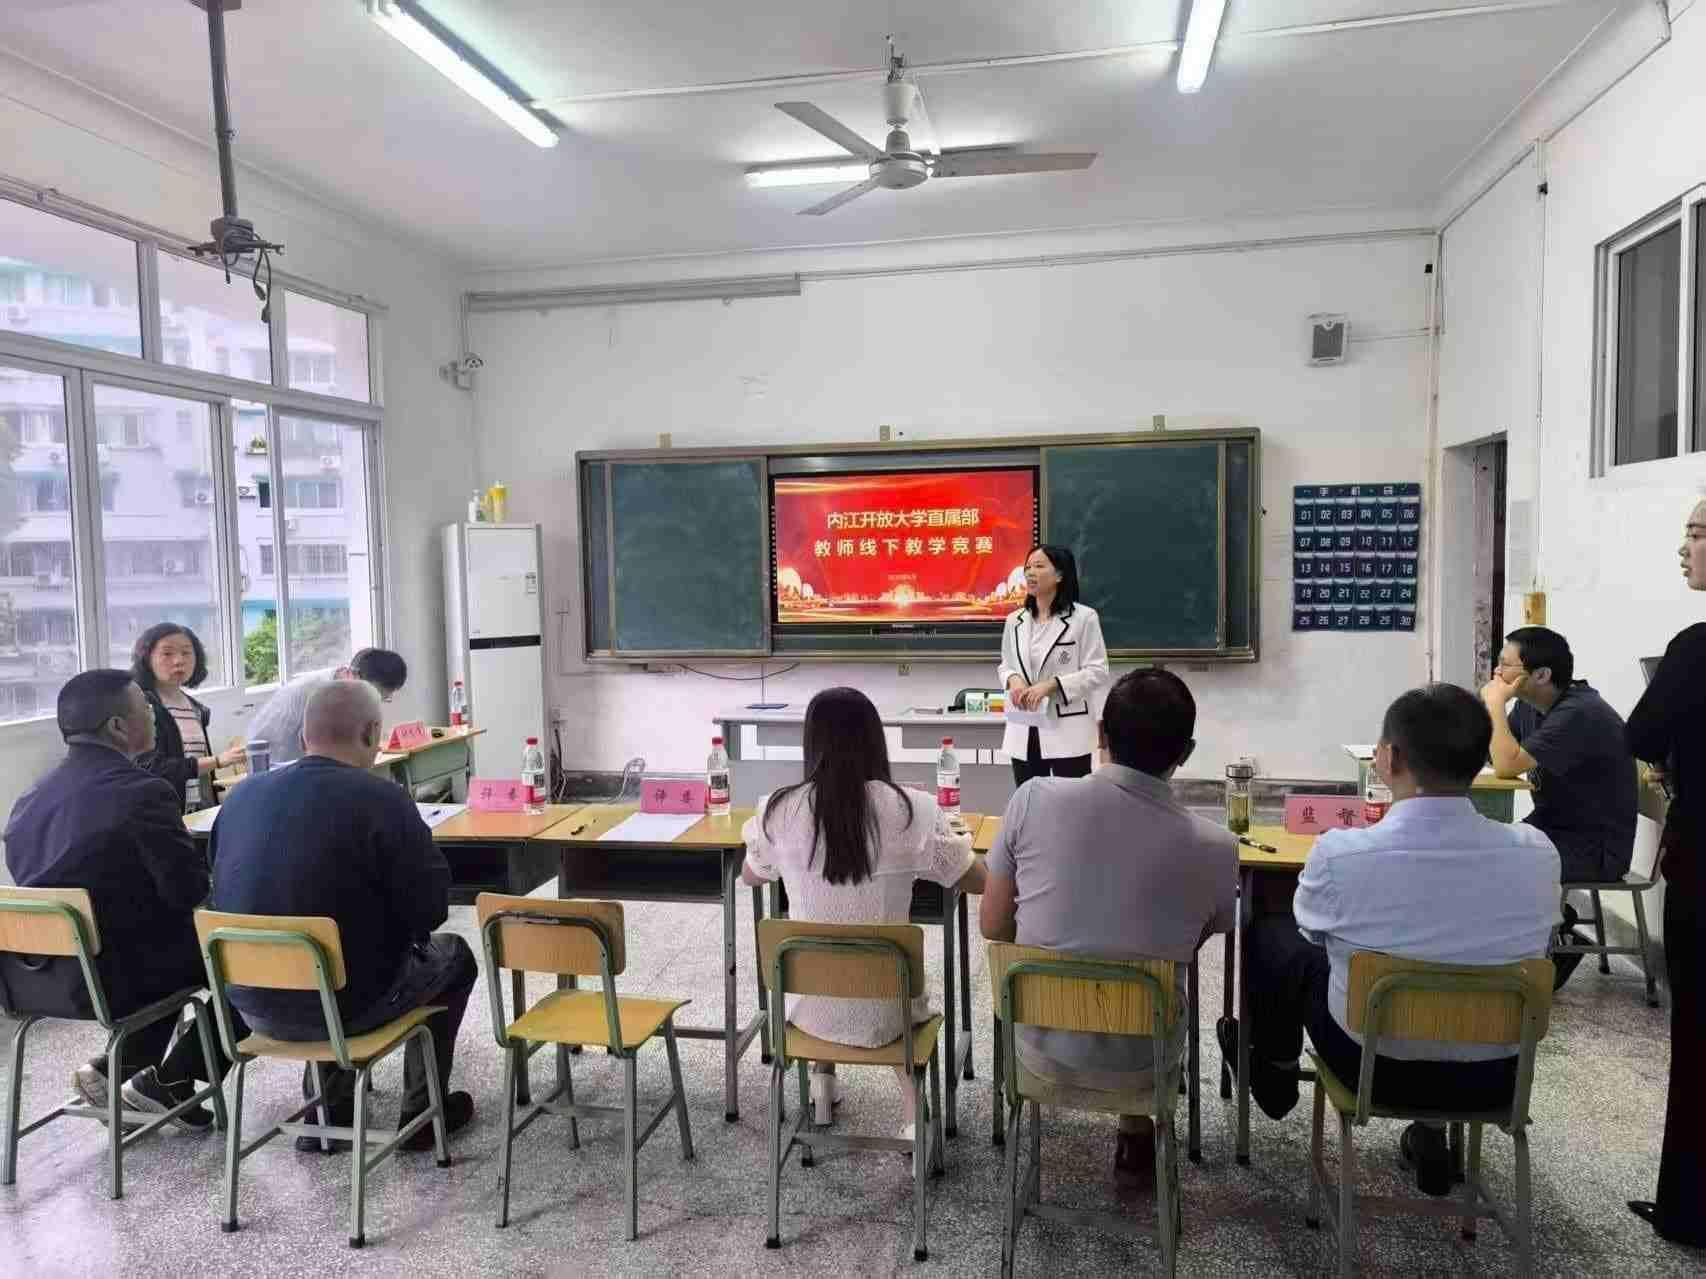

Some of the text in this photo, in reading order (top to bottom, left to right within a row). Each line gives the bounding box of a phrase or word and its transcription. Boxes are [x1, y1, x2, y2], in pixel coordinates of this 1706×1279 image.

[827, 507, 980, 529] 内江开放大学直属部
[1300, 510, 1312, 521] 01
[1320, 509, 1332, 521] 02
[1340, 509, 1353, 521] 03
[1360, 509, 1372, 520] 04
[1381, 508, 1393, 519] 05
[814, 536, 993, 557] 教师线下教学竞赛
[1300, 536, 1414, 548] 07 08 09 10 11 12
[1300, 562, 1414, 574] 13 14 15 16 17 18
[1301, 588, 1412, 599] 19 20 21 22 23 24
[1318, 615, 1329, 626] 26
[1337, 615, 1349, 625] 27
